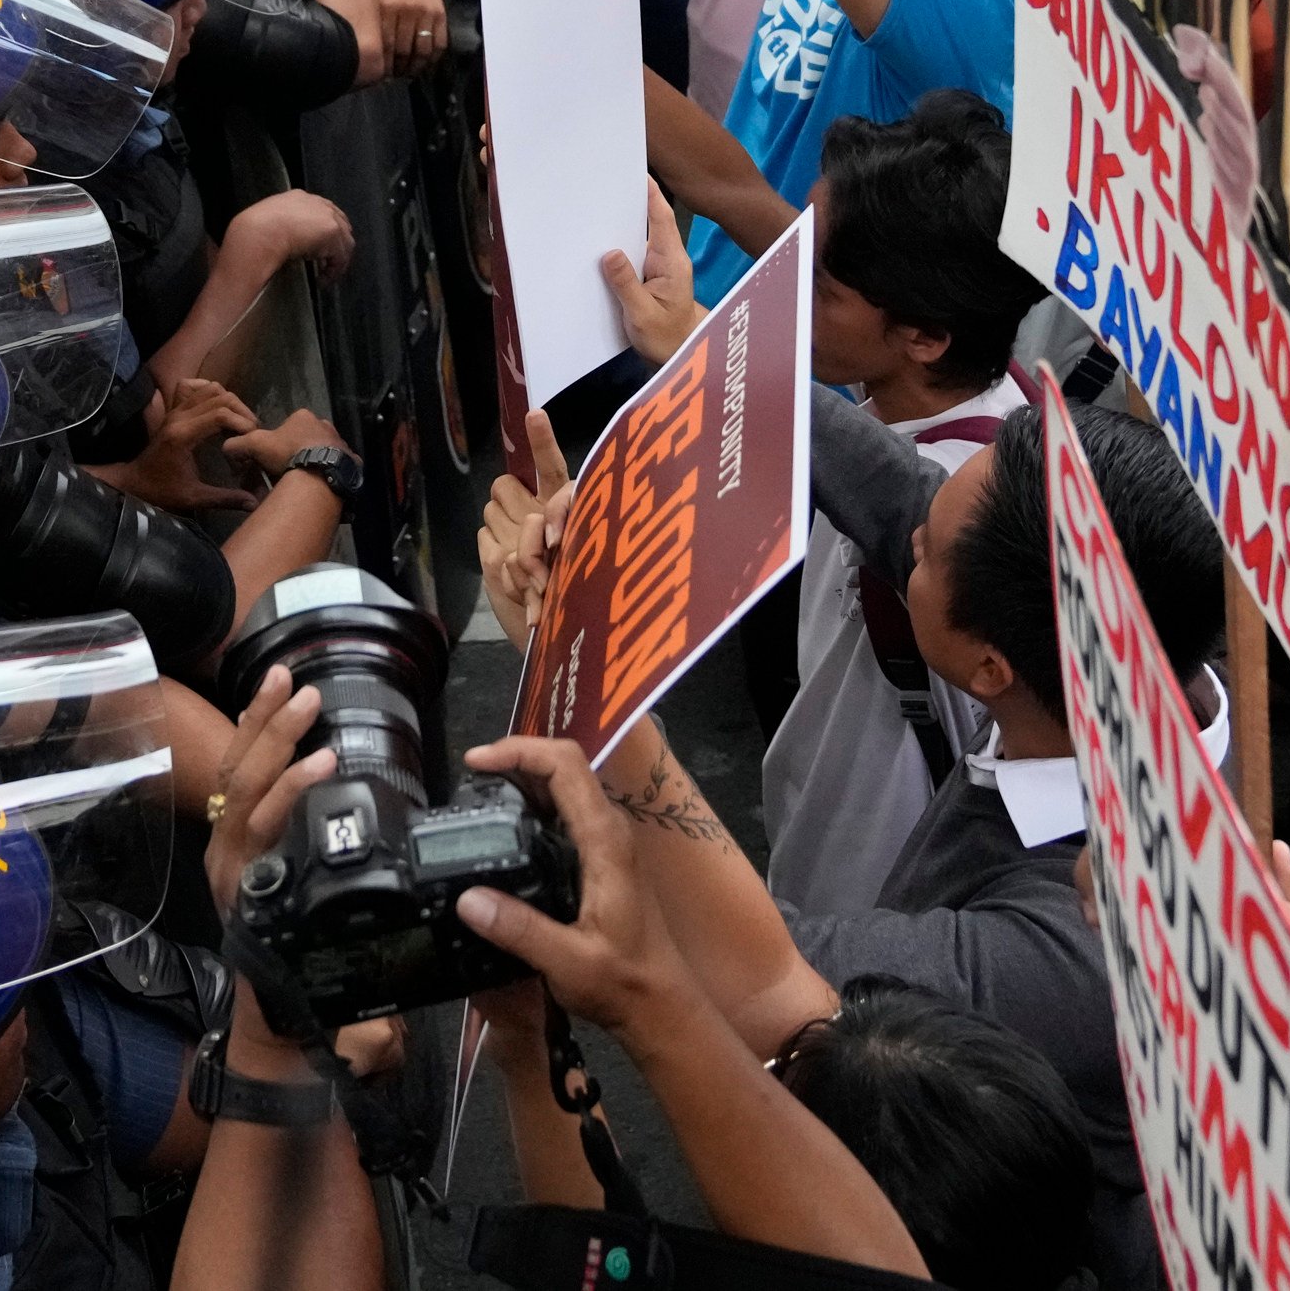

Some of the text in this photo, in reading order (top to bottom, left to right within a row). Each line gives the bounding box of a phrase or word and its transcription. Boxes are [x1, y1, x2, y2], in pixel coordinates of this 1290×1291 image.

[715, 299, 750, 500] #ENDIMPUNITY
[1053, 199, 1223, 516] BAYAN
[598, 335, 710, 731] REJOIN
[1067, 649, 1127, 899] FOR
